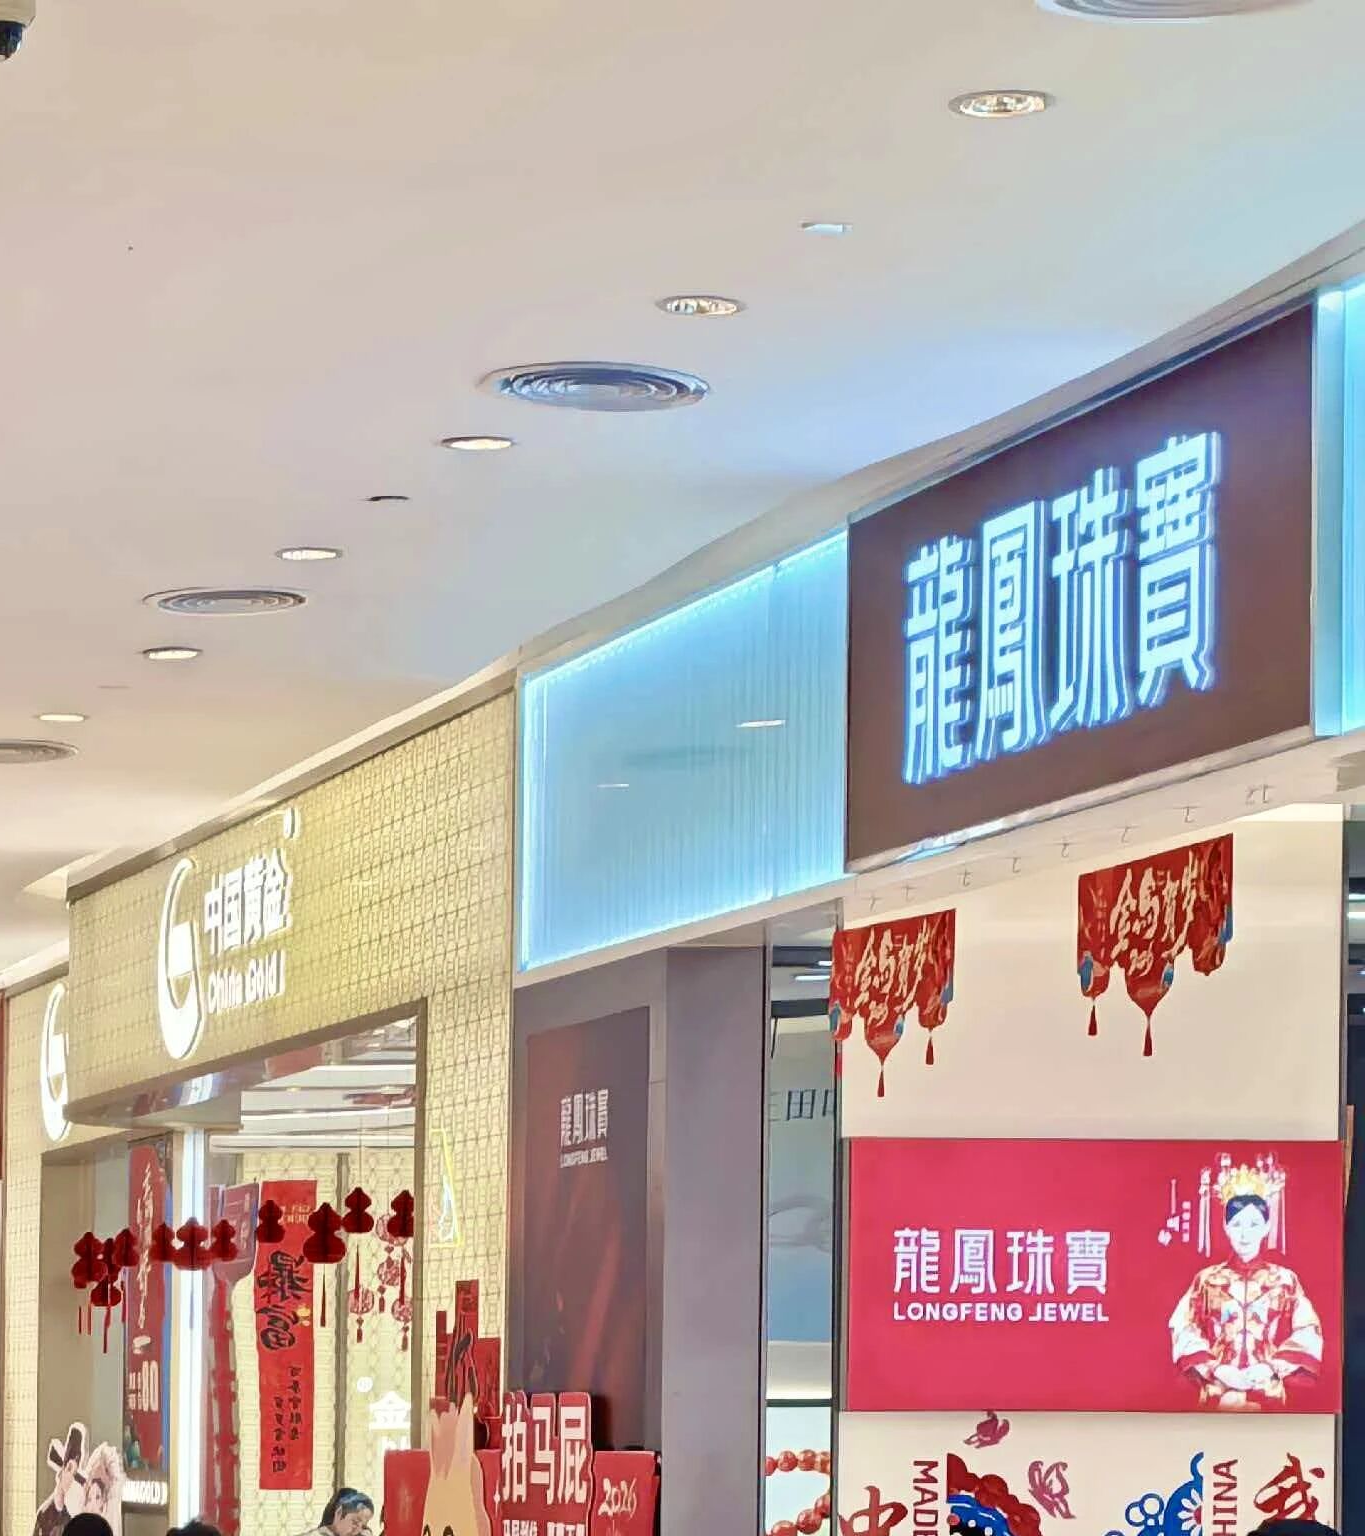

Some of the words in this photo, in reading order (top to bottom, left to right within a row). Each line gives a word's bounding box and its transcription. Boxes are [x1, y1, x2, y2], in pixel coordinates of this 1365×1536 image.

[903, 430, 1223, 785] 龍鳳珠寶
[204, 848, 292, 954] 中国黄金
[245, 951, 286, 1002] Gold
[893, 1228, 1111, 1294] 龍鳳珠寶
[893, 1302, 1024, 1322] LONGFENG
[1029, 1302, 1110, 1322] JEWEL
[502, 1403, 588, 1505] 拍马屁
